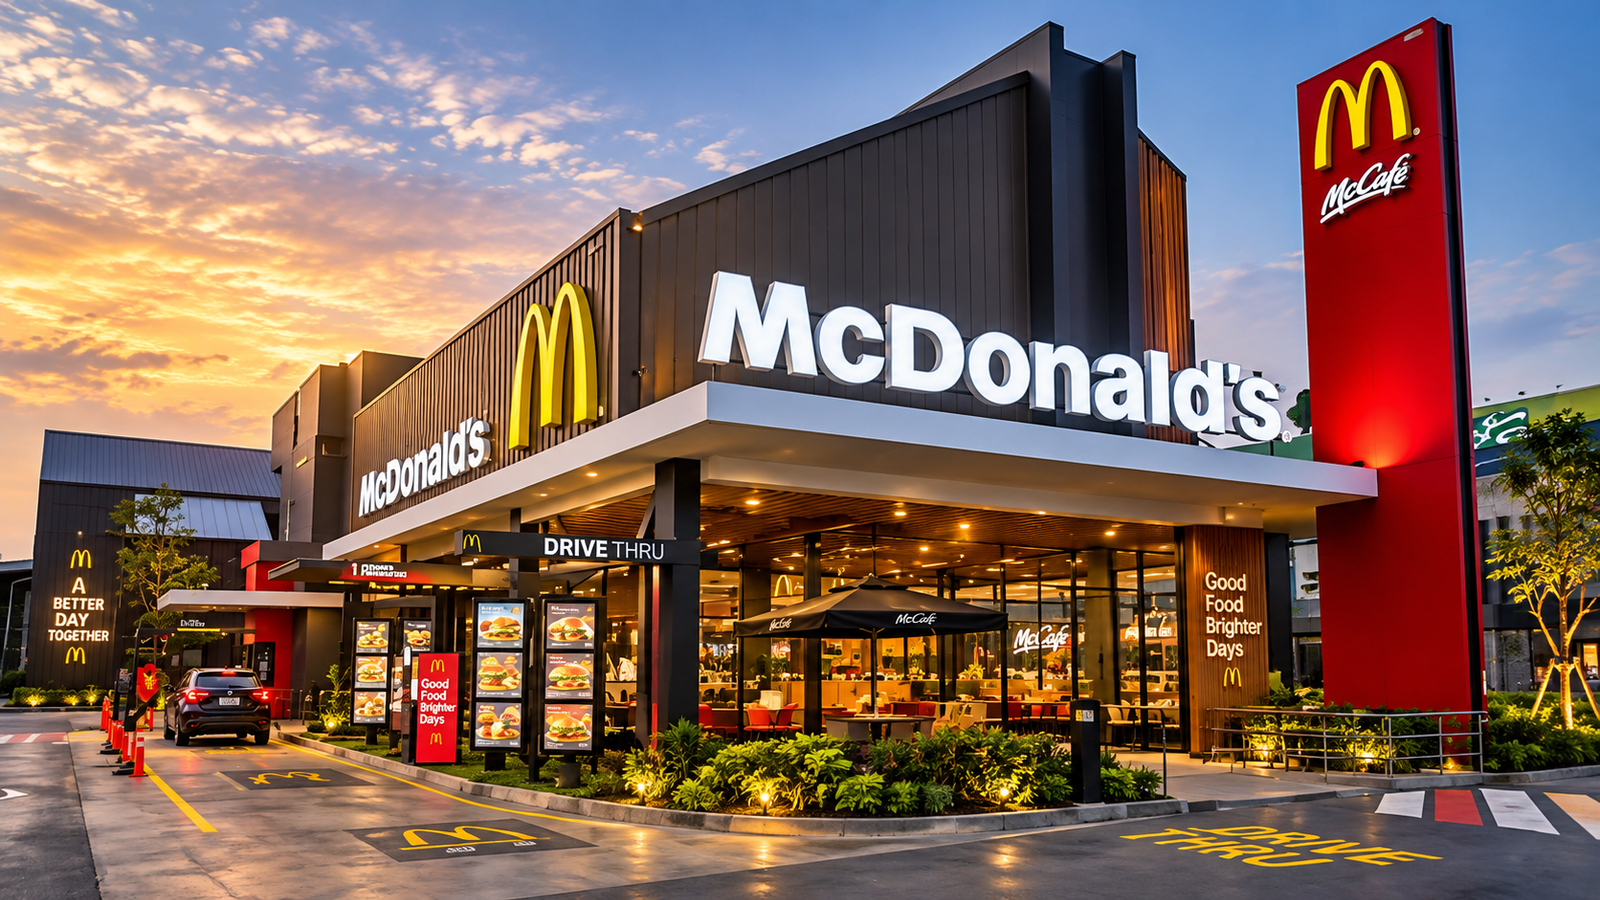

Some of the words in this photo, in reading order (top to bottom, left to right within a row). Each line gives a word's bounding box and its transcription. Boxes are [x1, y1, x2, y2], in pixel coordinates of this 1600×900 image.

[698, 270, 1282, 442] McDonald's
[358, 417, 491, 517] McDonald's
[544, 537, 608, 558] DRIVE
[612, 541, 665, 560] THRU
[71, 576, 86, 594] A
[1205, 571, 1247, 591] Good
[53, 597, 105, 611] BETTER
[1205, 594, 1244, 613] Food
[55, 612, 89, 627] DAY
[1206, 617, 1262, 638] Brighter
[48, 629, 109, 642] TOGETHER
[1206, 639, 1244, 661] Days
[421, 678, 449, 689] Good
[420, 690, 447, 701] Food
[420, 702, 457, 715] Brighter
[419, 714, 445, 726] Days
[1119, 827, 1334, 868] THRU
[1187, 824, 1443, 866] DRIVE
